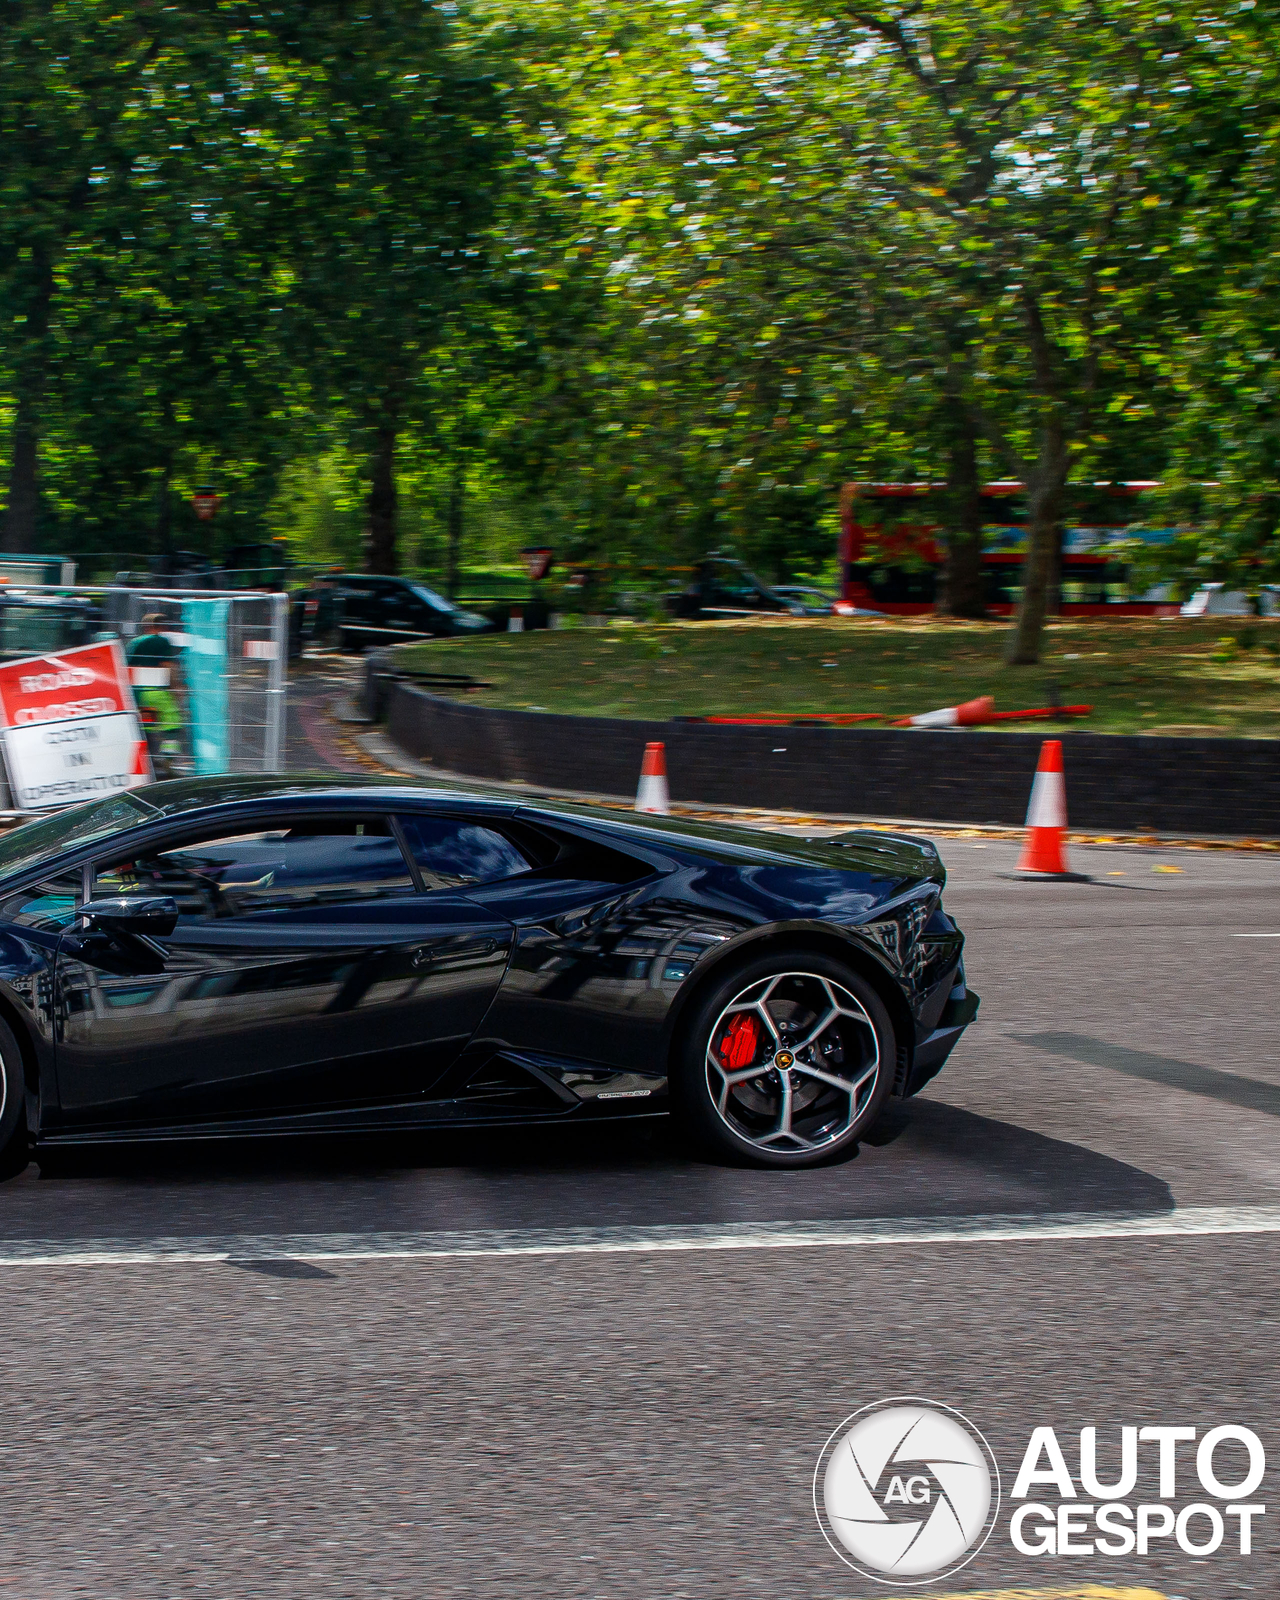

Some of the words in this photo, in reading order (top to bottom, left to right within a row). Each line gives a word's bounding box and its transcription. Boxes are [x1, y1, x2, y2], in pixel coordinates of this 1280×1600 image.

[19, 667, 96, 693] ROAD
[14, 698, 117, 725] CLOSED
[23, 774, 129, 800] OPERATIO
